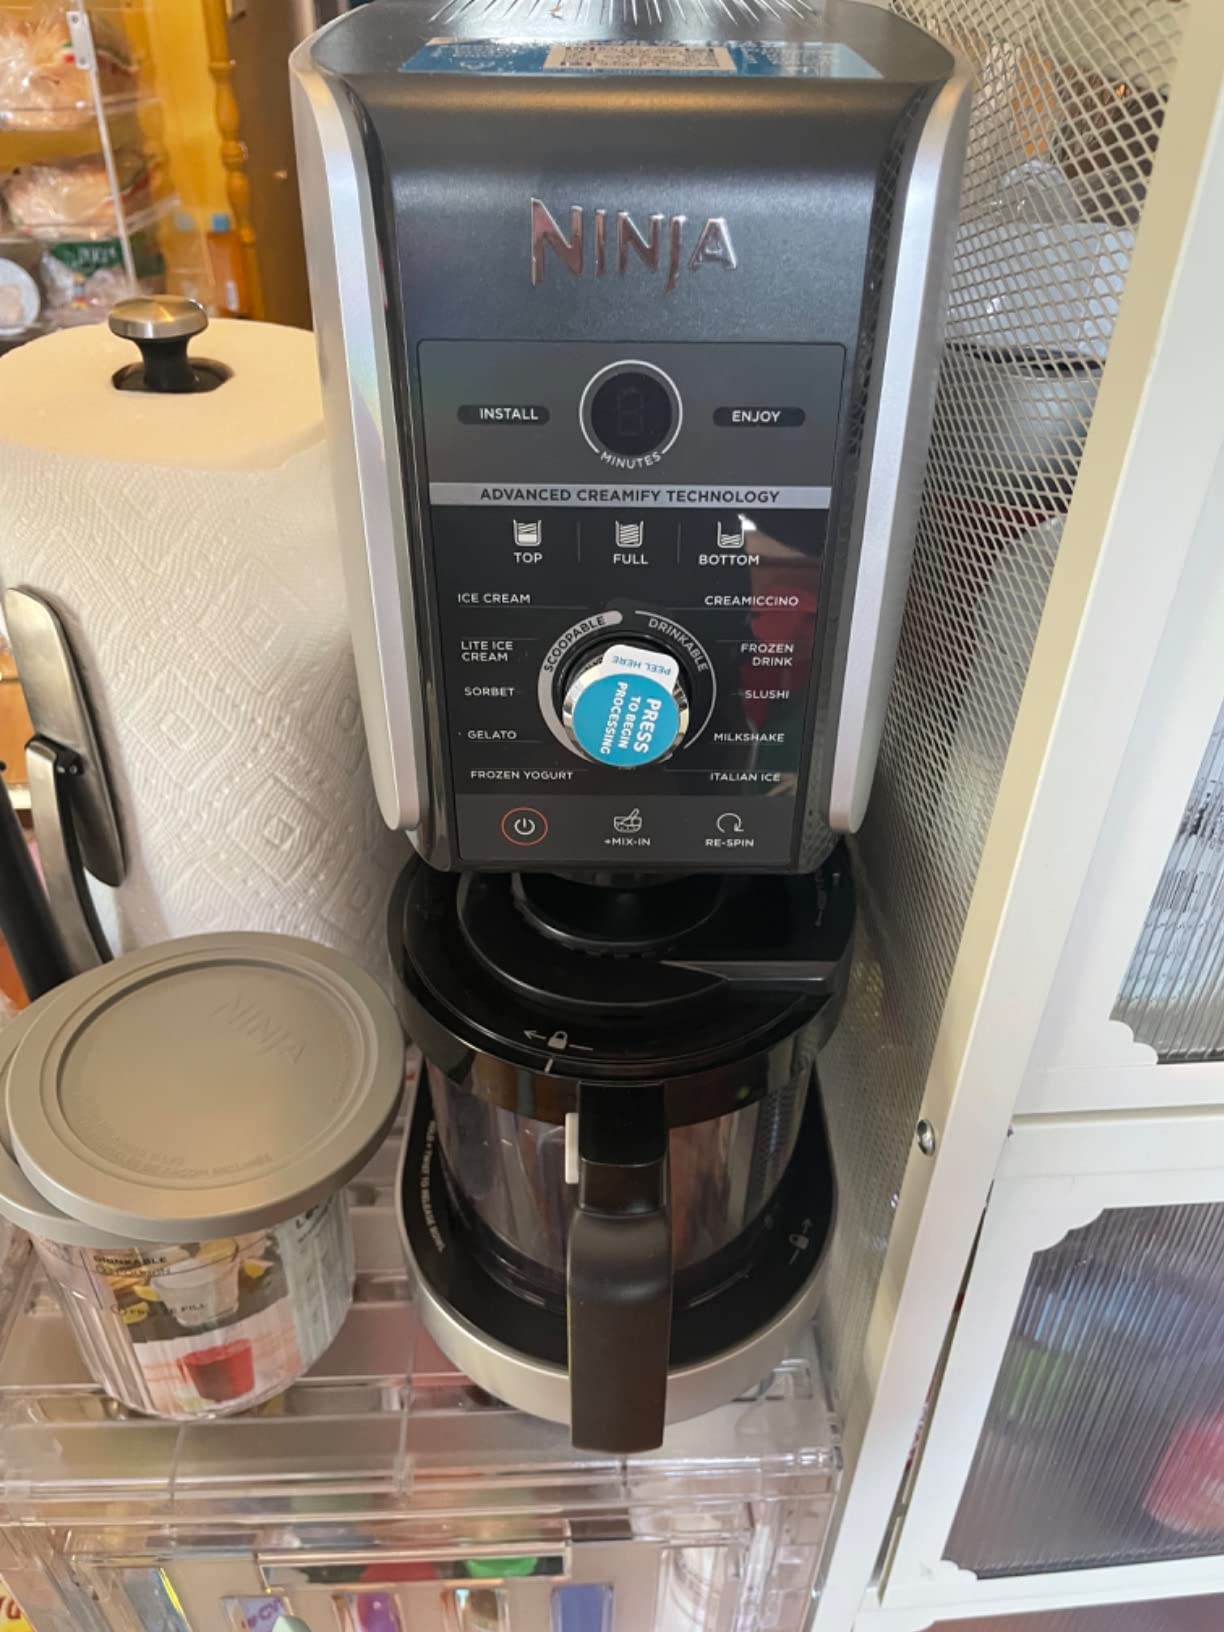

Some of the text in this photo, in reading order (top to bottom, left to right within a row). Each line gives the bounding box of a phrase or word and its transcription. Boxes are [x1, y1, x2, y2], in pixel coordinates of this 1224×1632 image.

[530, 197, 738, 295] NINJA
[479, 407, 539, 421] INSTALL
[731, 410, 781, 424] ENJOY
[600, 450, 662, 470] MINUTES
[480, 487, 781, 505] ADVANCED CREAMIFY TECHNOLOGY
[513, 551, 544, 565] TOP
[613, 553, 649, 566] FULL
[699, 553, 760, 567] BOTTOM
[457, 592, 531, 605] ICE CREAM
[704, 595, 800, 607] CREAMICCINO
[461, 640, 514, 651] LITE ICE
[543, 615, 606, 673] SCOOPABLE
[648, 617, 709, 673] DRINKABLE
[740, 642, 795, 654] FROZEN
[461, 651, 509, 662] CREAM
[752, 656, 793, 667] DRINK
[612, 654, 673, 676] PEEL HERE
[464, 686, 516, 697] SORBET
[744, 689, 790, 700] SLUSHI
[627, 696, 642, 712] TO
[600, 681, 629, 756] PROCESSING
[617, 713, 637, 750] BEGIN
[632, 697, 662, 754] PRESS
[467, 730, 518, 741] GELATO
[713, 732, 785, 743] MILKSHAKE
[470, 770, 575, 782] FROZEN YOGURT
[709, 772, 782, 783] ITALIAN ICE
[603, 837, 651, 848] +MIX-IN
[704, 838, 755, 849] RE-SPIN
